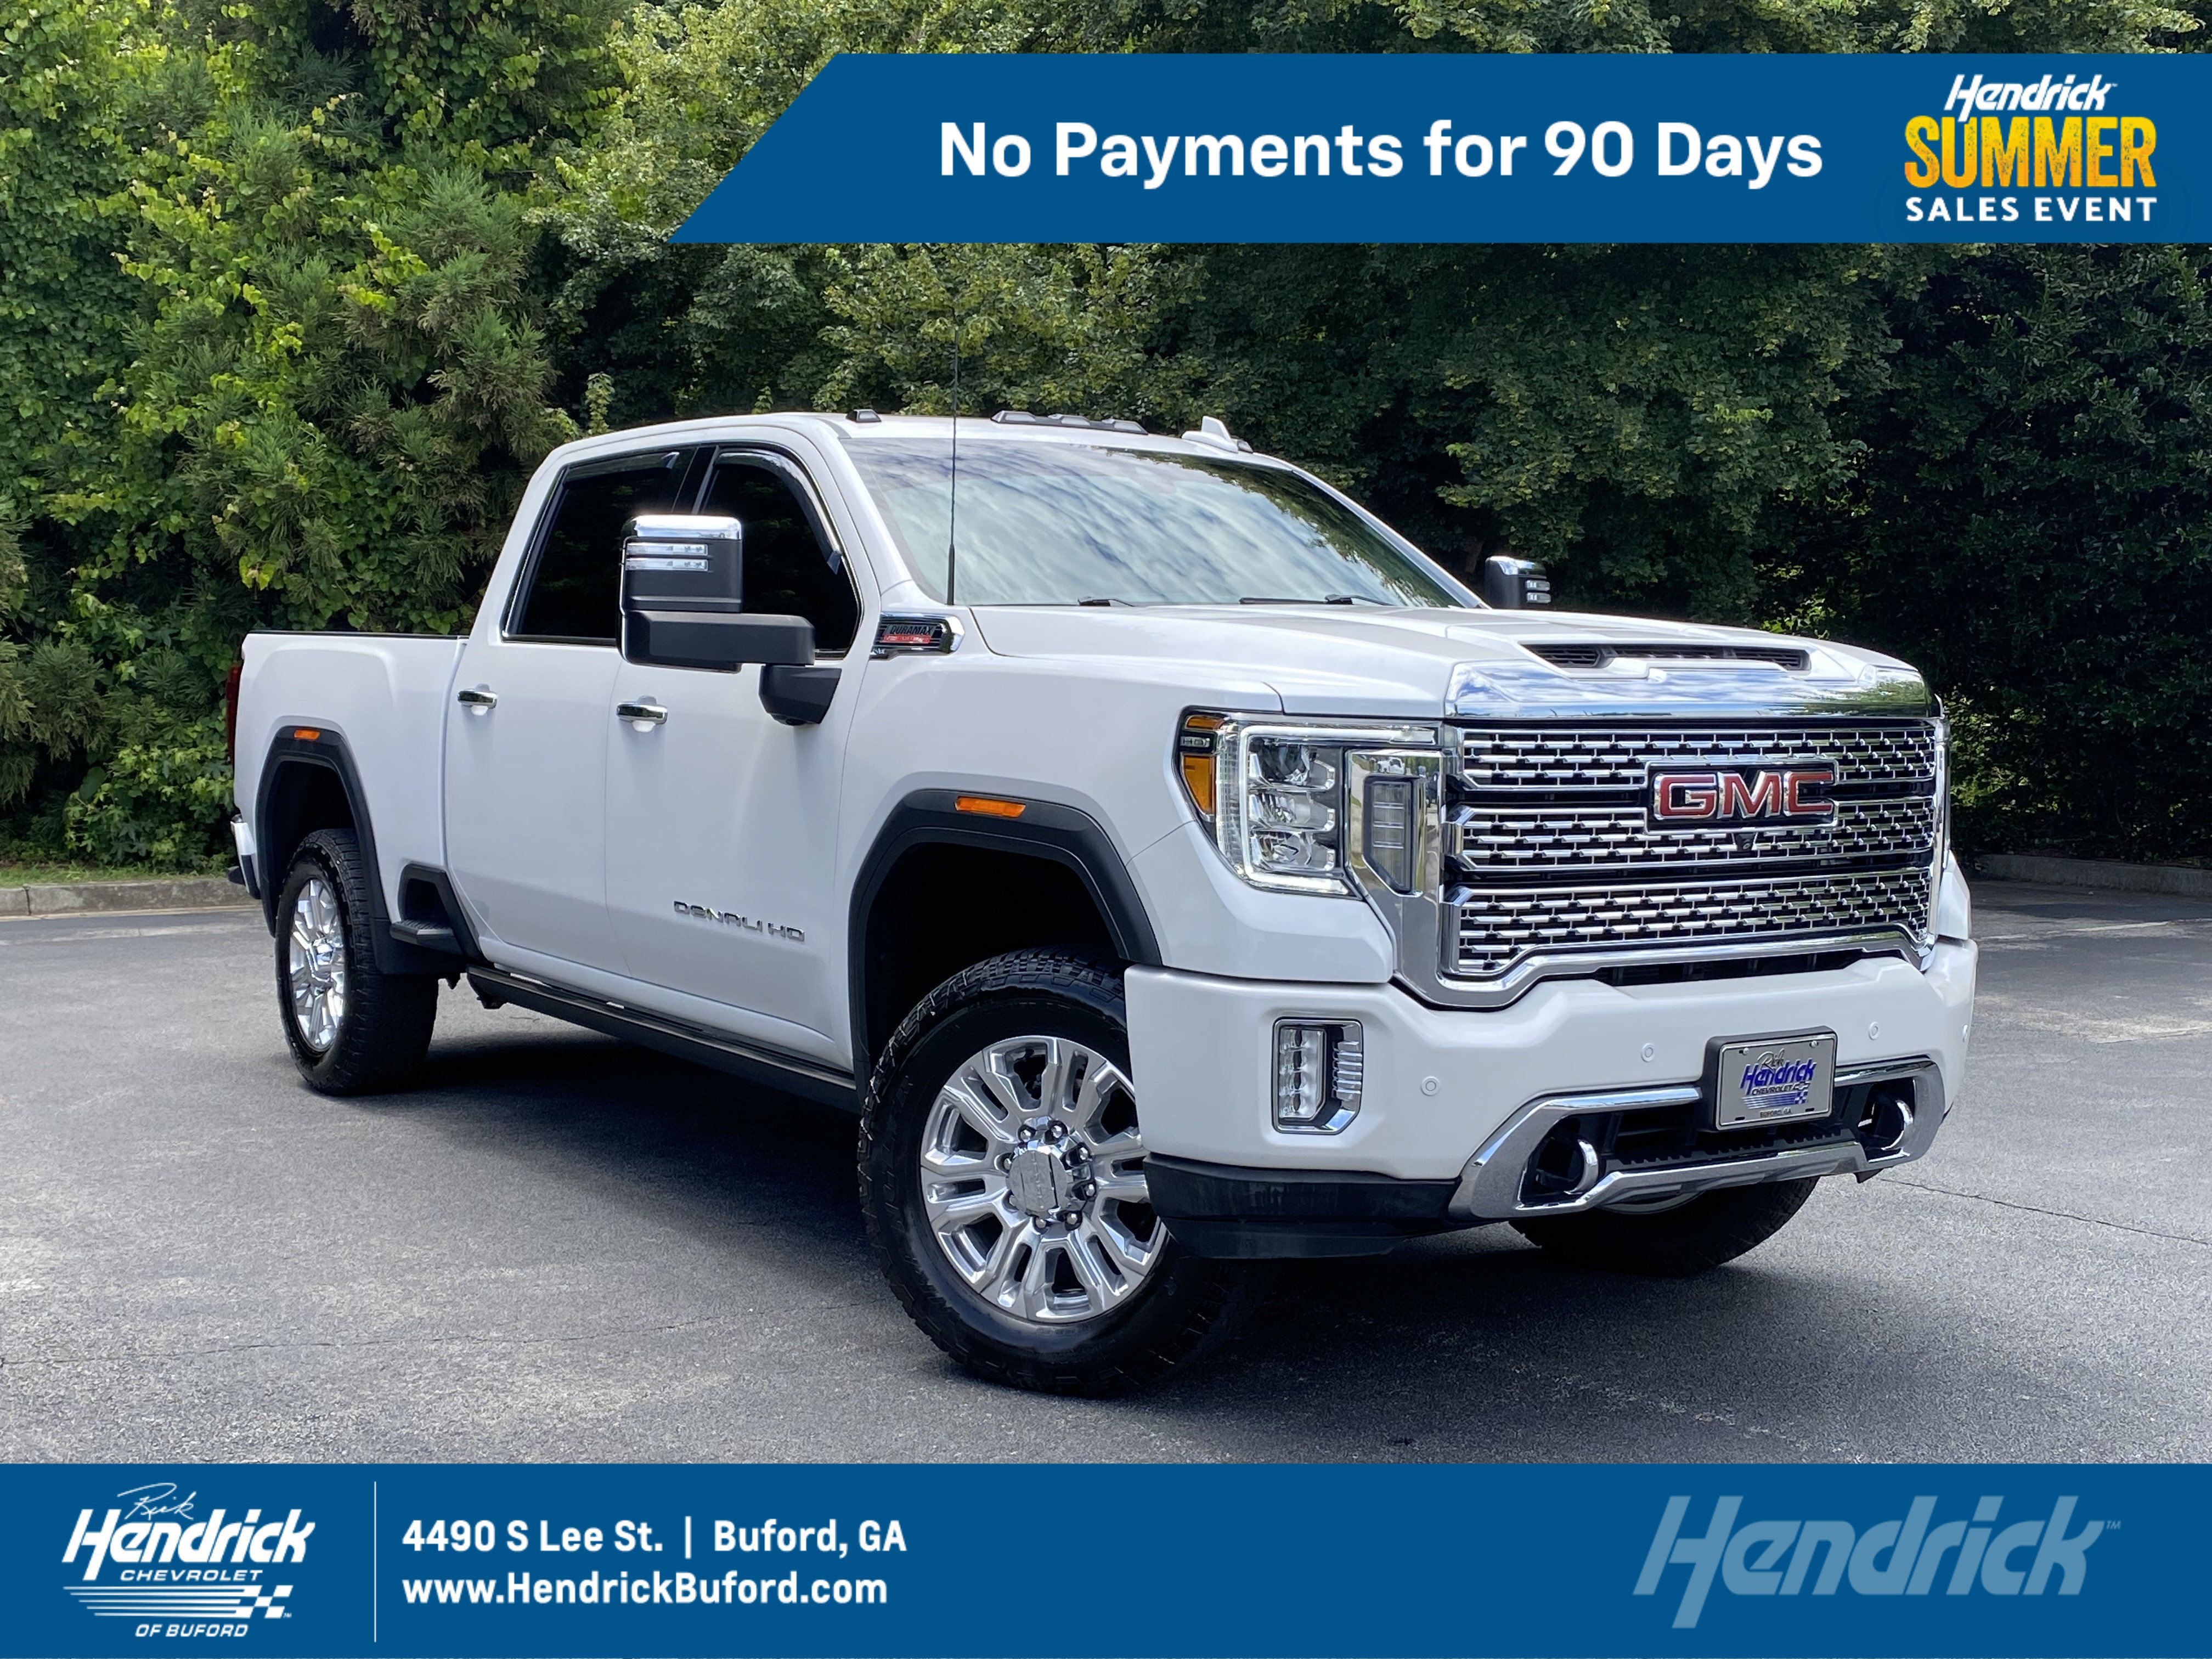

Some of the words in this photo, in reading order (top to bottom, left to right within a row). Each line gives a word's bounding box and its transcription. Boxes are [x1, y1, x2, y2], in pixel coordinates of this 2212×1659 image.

[889, 625, 934, 635] DURAMAX
[1653, 770, 1833, 820] GMC
[674, 900, 763, 933] DENALI
[768, 922, 805, 941] HD
[1740, 1058, 1817, 1095] Hendrick
[1752, 1084, 1793, 1095] CHEVROLET
